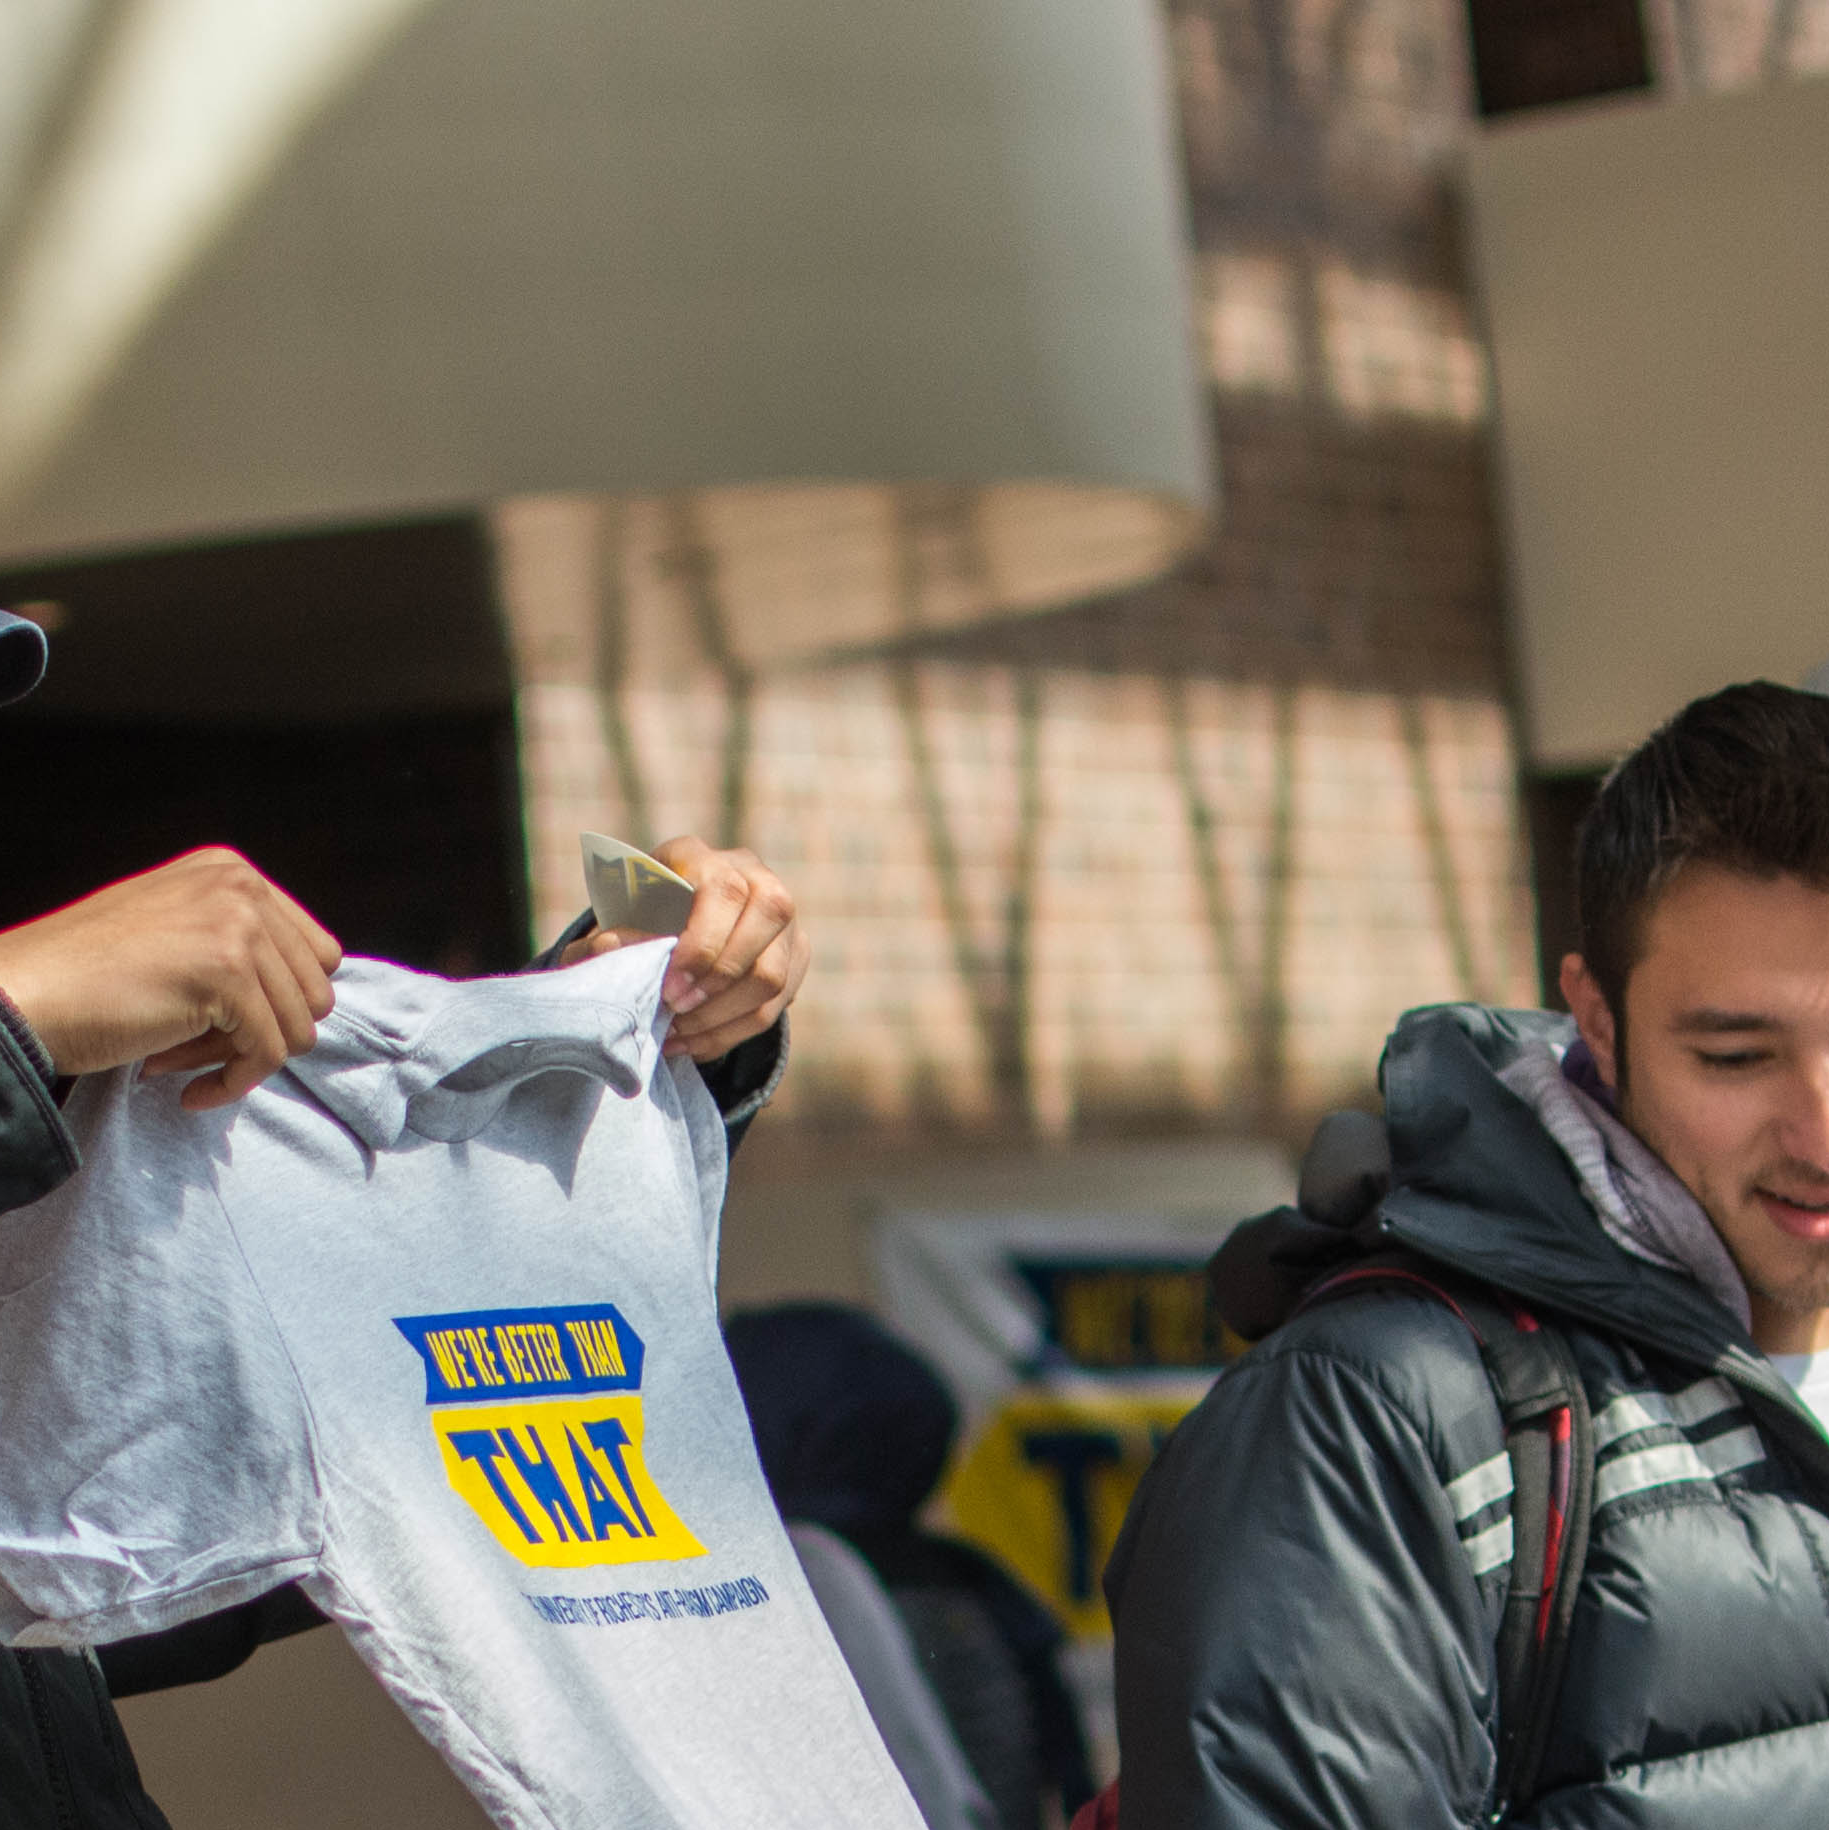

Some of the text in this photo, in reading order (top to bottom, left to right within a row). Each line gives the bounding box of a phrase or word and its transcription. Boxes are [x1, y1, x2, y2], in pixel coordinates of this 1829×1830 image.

[424, 1319, 627, 1390] WE'RE BETTER THAN
[446, 1417, 657, 1545] THAT
[705, 1574, 770, 1616] CAMPAIGN
